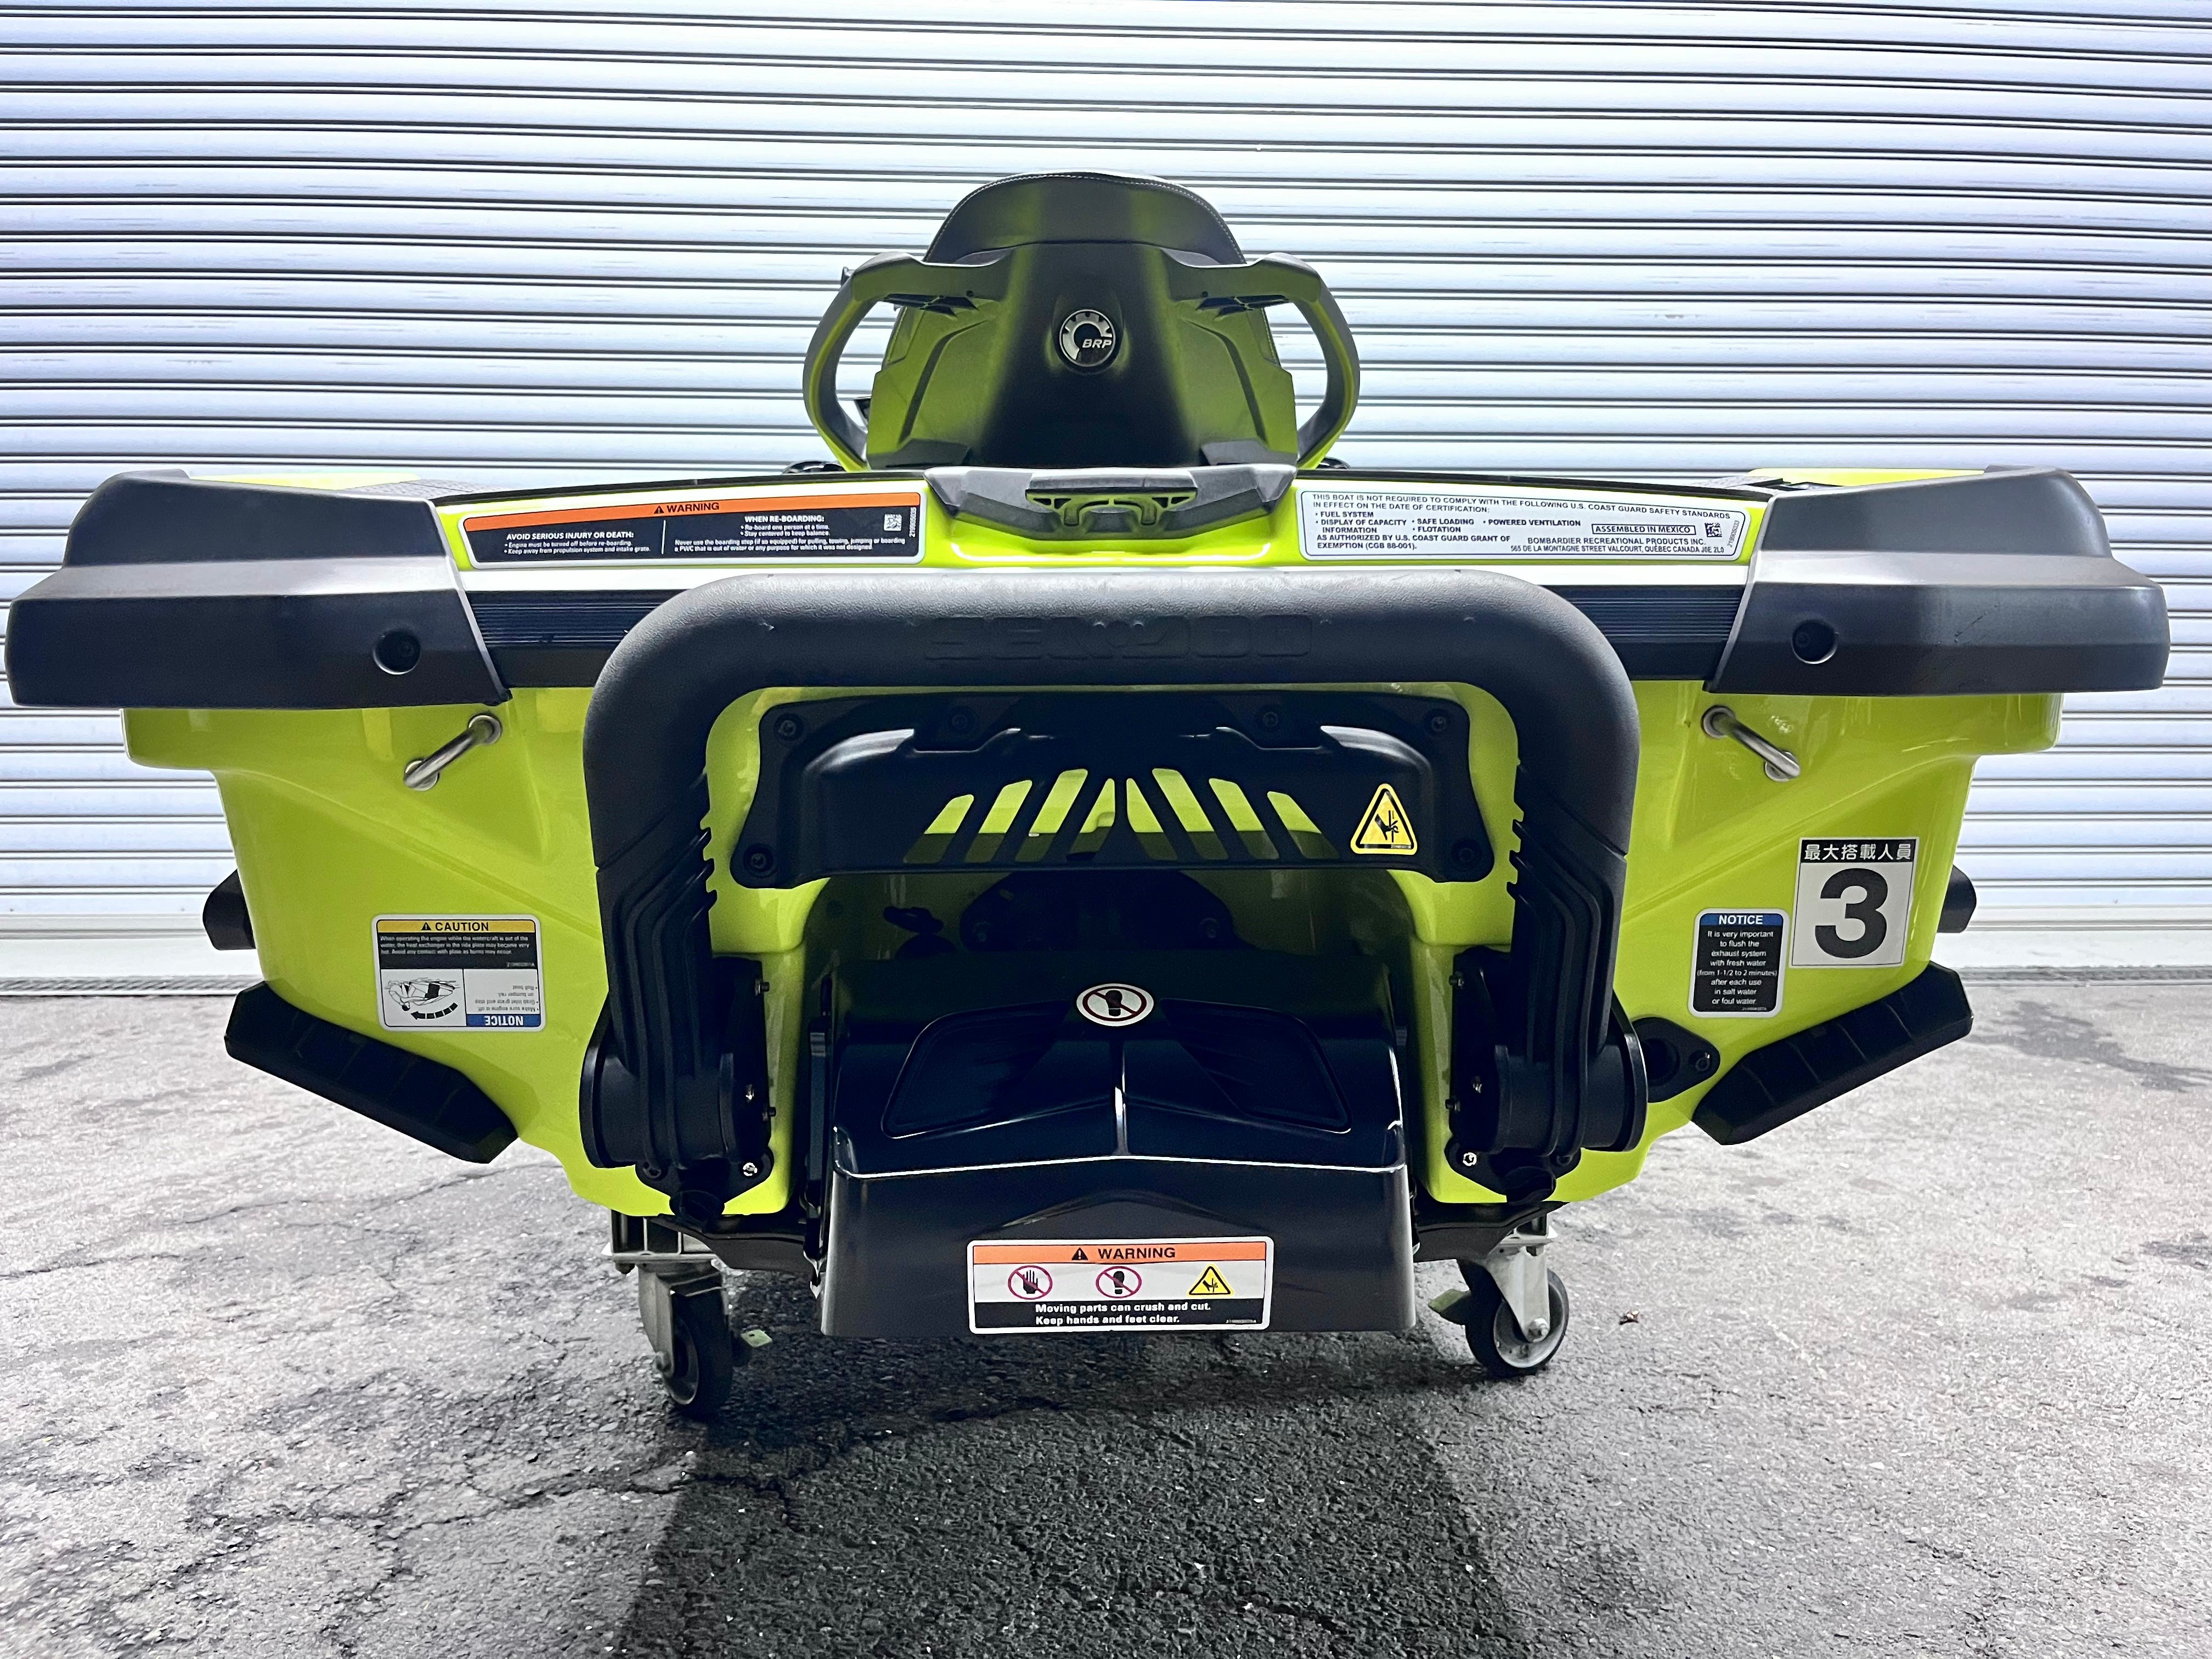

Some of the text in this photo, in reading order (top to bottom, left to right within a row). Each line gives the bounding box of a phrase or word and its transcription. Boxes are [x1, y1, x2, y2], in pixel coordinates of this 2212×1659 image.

[1082, 338, 1112, 348] BRP
[667, 502, 719, 512] WARNING
[1682, 510, 1730, 519] STANDARDS
[1804, 844, 1911, 860] 最大搭載人員
[1815, 868, 1888, 958] 3
[1719, 915, 1763, 924] NOTICE
[435, 922, 489, 931] CAUTION
[484, 1015, 523, 1025] NOTICE
[1098, 1247, 1175, 1260] WARNING
[1036, 1304, 1077, 1314] Moving
[1080, 1304, 1108, 1314] parts
[1134, 1302, 1165, 1312] crush
[1168, 1302, 1188, 1311] and
[1036, 1314, 1180, 1327] Keep hands and feet clear.
